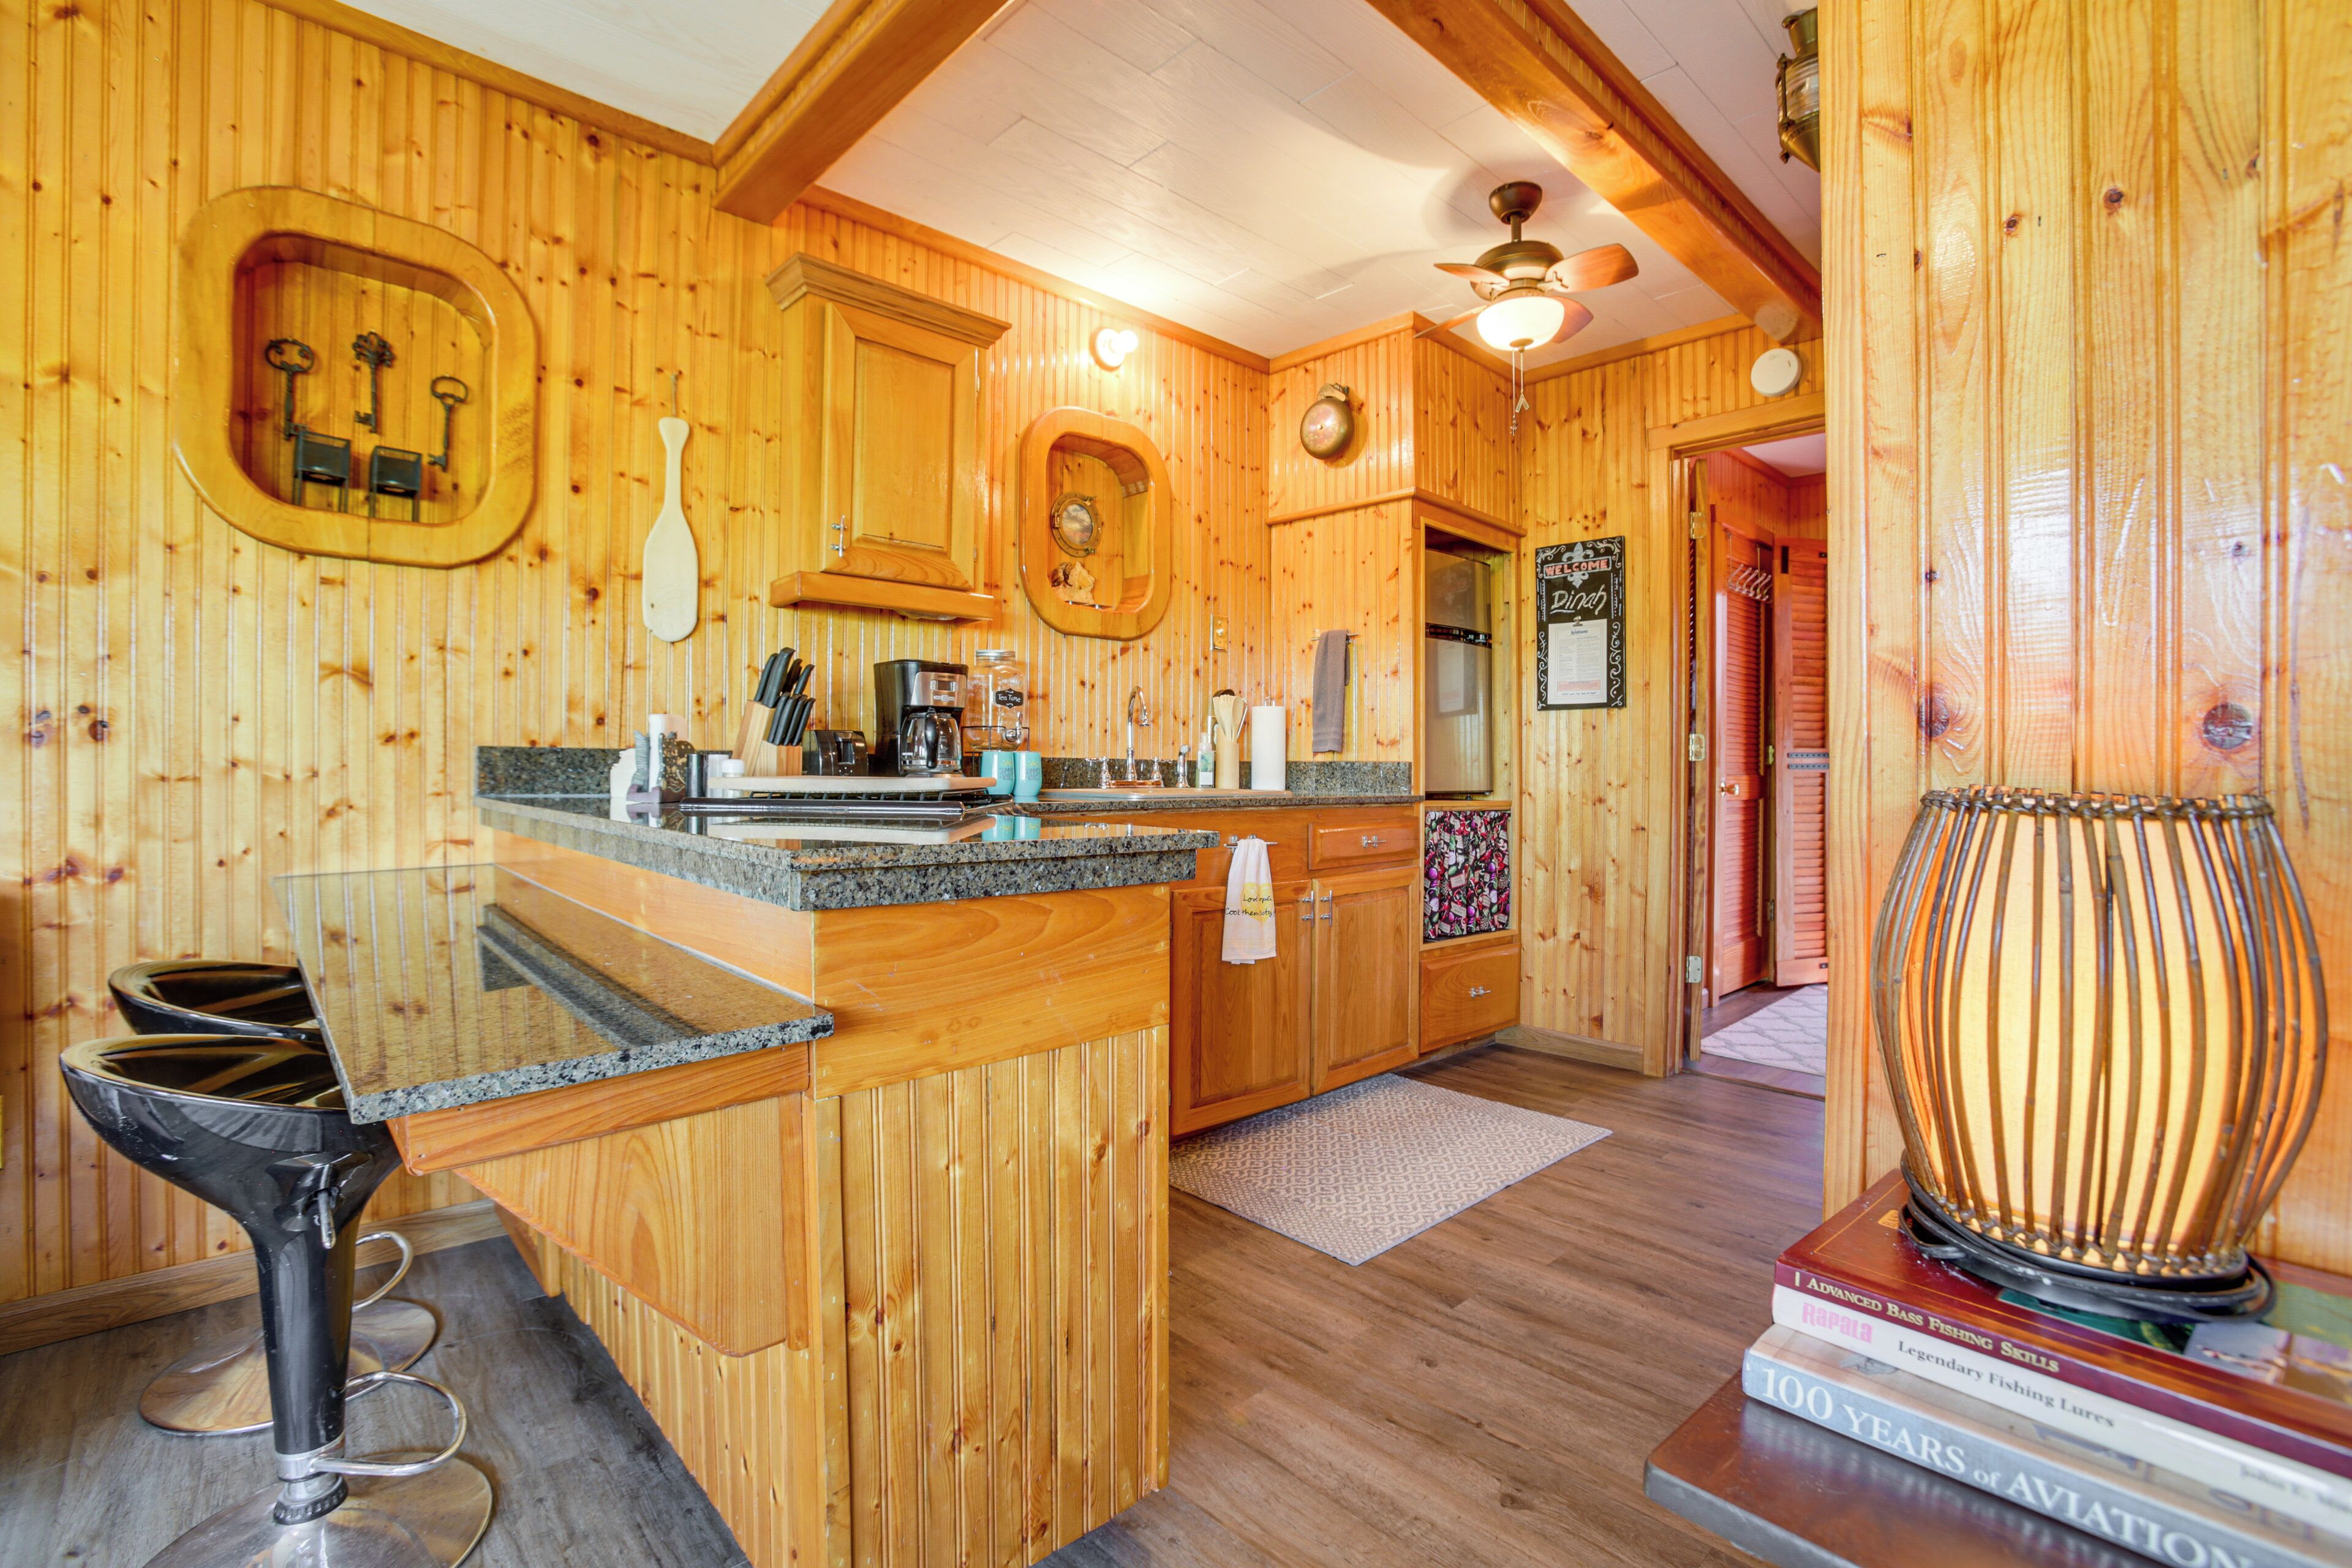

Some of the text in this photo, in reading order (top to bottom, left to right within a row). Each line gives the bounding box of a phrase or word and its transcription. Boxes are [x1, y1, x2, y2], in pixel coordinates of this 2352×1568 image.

[1545, 559, 1608, 576] WELCOME
[1551, 584, 1607, 615] Dinah
[1802, 1302, 1873, 1344] Rapala
[1807, 1279, 2059, 1373] ADVANCED BASS FISHING SKILLS
[1899, 1341, 2115, 1428] Legendary Fishing Lures
[1762, 1368, 1834, 1420] 100
[1842, 1403, 1966, 1474] YEARS
[1973, 1468, 2001, 1489] of
